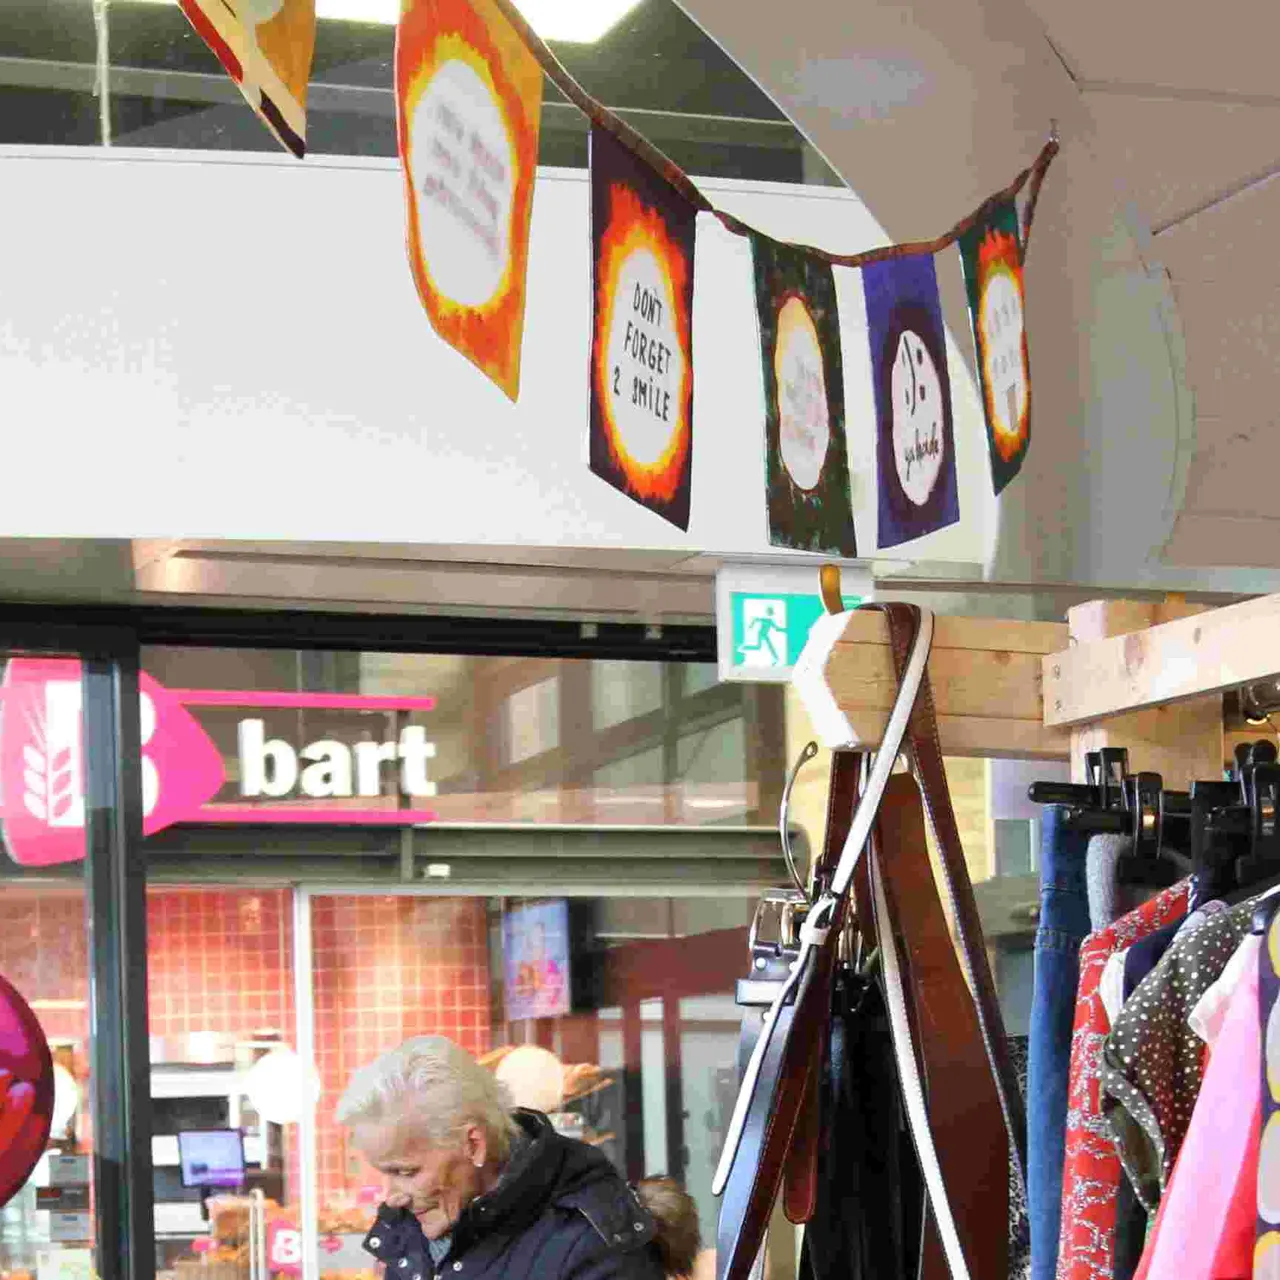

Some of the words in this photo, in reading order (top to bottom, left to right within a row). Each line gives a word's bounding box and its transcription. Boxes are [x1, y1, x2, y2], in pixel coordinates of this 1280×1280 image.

[623, 319, 671, 374] FORGET
[613, 365, 620, 396] 2
[237, 717, 438, 798] bart
